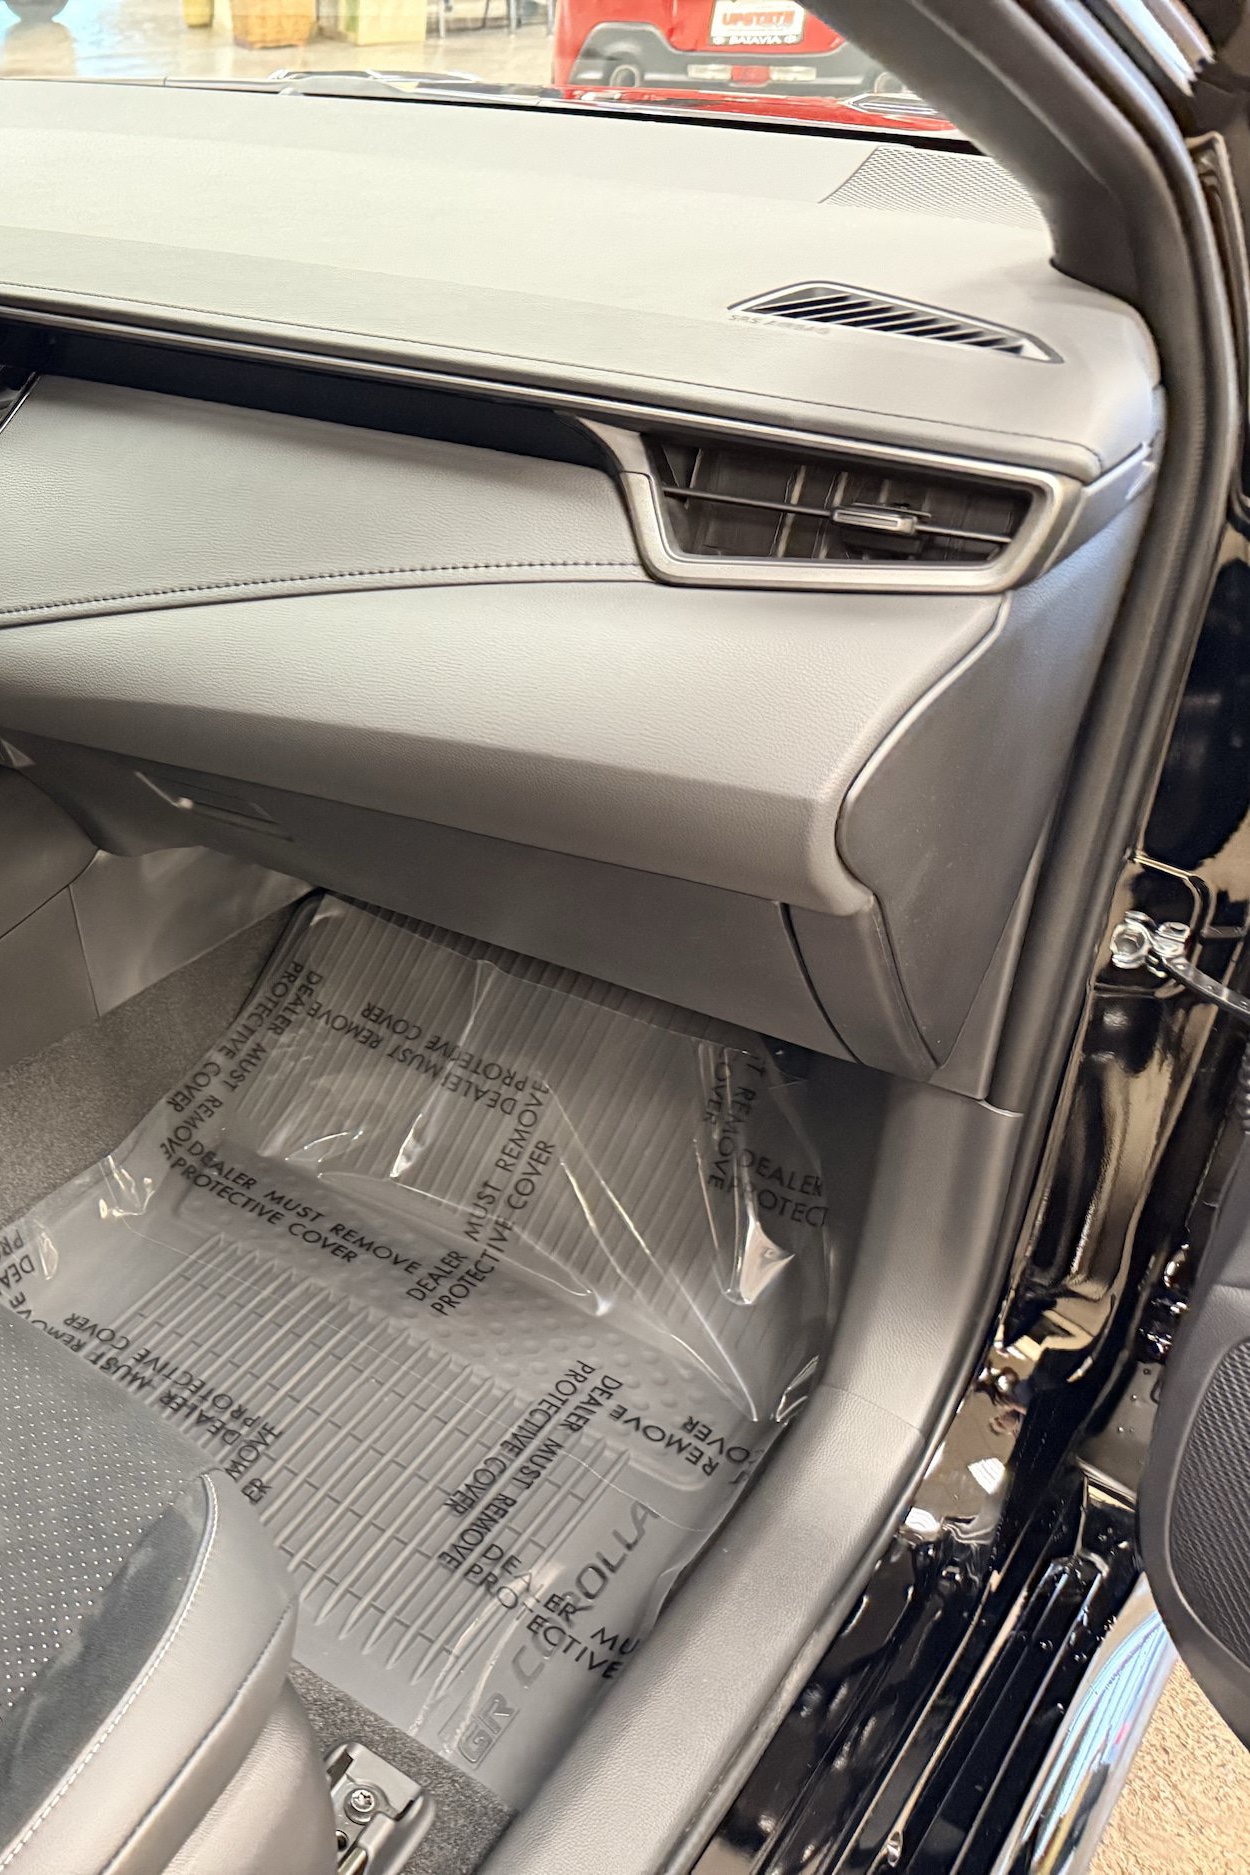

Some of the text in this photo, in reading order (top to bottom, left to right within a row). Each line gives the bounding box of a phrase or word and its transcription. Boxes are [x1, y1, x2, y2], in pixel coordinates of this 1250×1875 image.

[166, 961, 303, 1113] PROTECTIVE COVER
[268, 971, 323, 1036] DEALER
[361, 1002, 529, 1092] PROTEIVE COVER
[223, 1043, 269, 1092] MUST
[306, 1001, 517, 1115] DEALE MUST REMOVE
[406, 1080, 550, 1301] DEALER MUST REMOVE
[708, 1086, 756, 1190] REMOVE
[170, 1157, 359, 1263] PROTECTIVE COVER
[188, 1141, 422, 1274] DEALER MUST REMOVE
[430, 1139, 556, 1316] PROTECTIVE COVER
[63, 1312, 259, 1429] PROTECTIVE COVER
[87, 1350, 154, 1391] MUST
[159, 1392, 241, 1446] DEALER
[223, 1422, 283, 1484] MOVE
[438, 1375, 623, 1570] DEALER MUST REMOVE
[443, 1360, 595, 1515] PROTECTIVE COVER
[609, 1404, 720, 1476] REMOVE
[680, 1416, 760, 1463] OVER
[457, 1500, 661, 1764] GR COROLLA
[590, 1627, 640, 1654] MU
